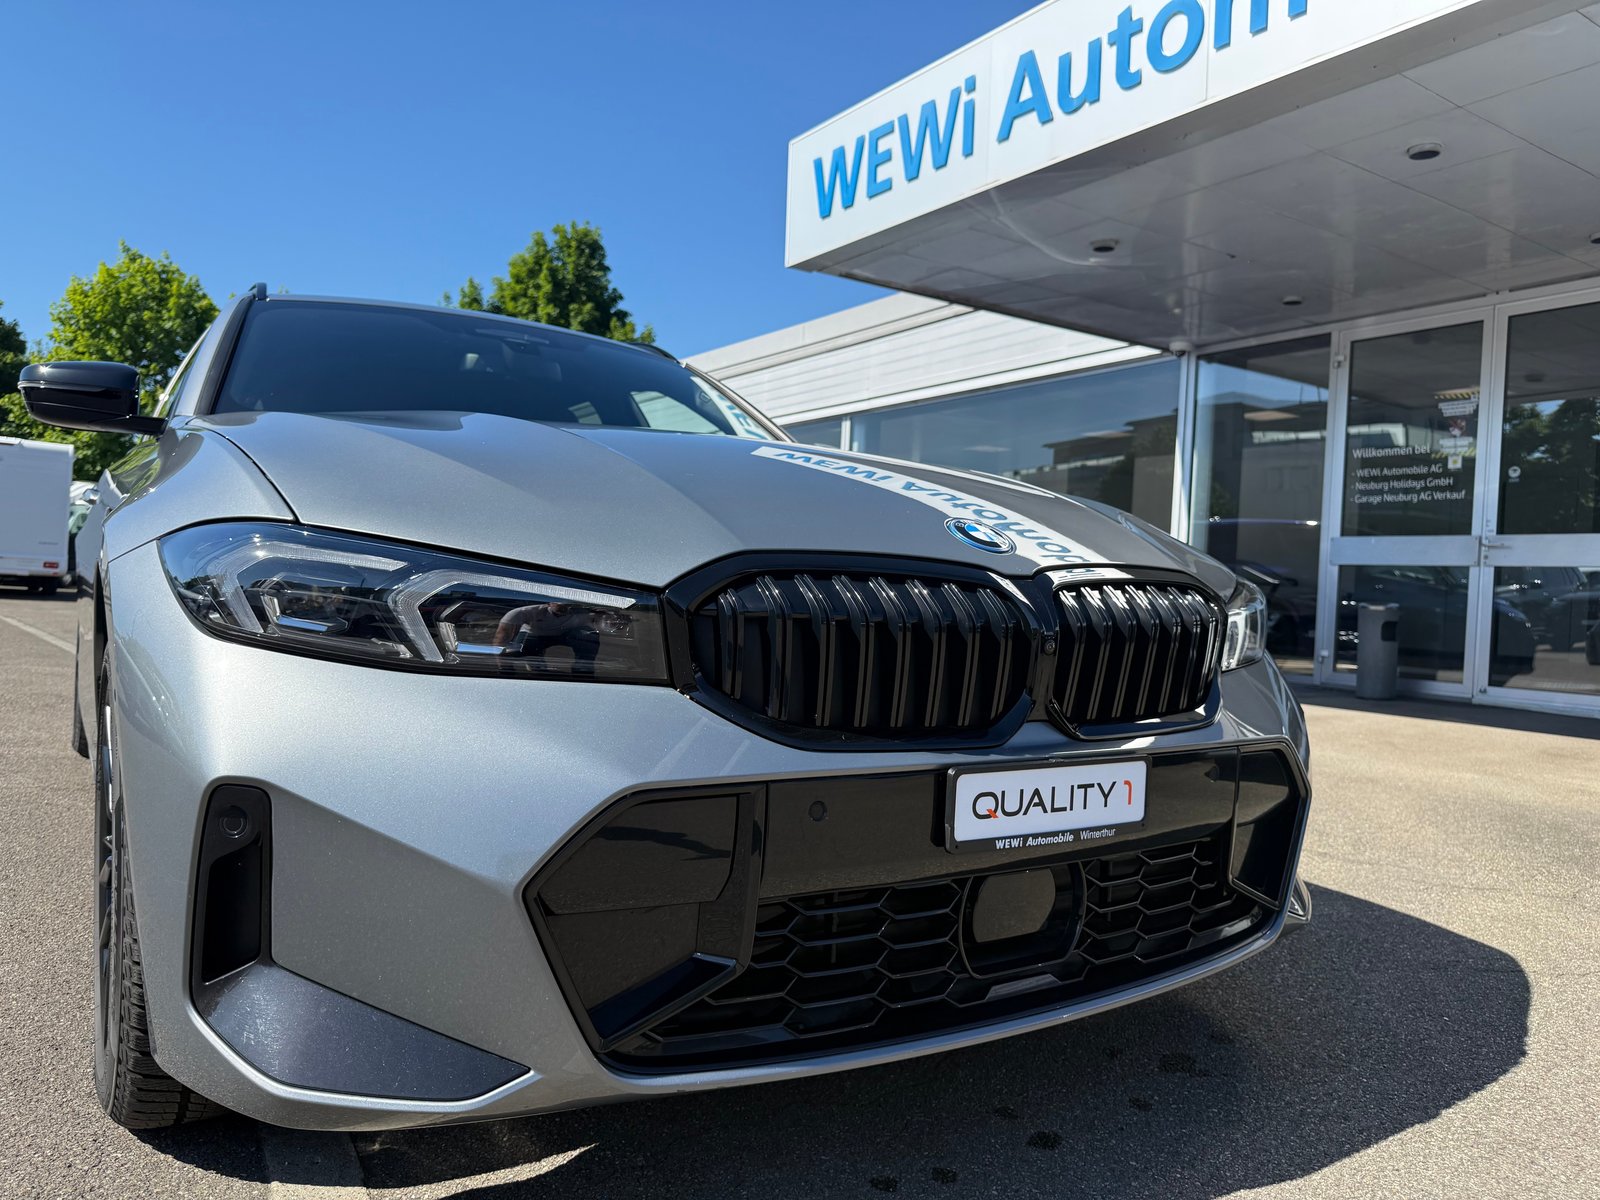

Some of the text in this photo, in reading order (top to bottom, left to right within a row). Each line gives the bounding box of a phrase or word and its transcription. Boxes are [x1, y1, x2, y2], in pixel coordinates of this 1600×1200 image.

[813, 75, 976, 219] WEWi
[1352, 446, 1413, 459] Willkommen
[1382, 465, 1428, 477] Automobile
[1430, 464, 1443, 474] AG
[1355, 477, 1453, 491] Neuburg Holidays GmbH
[1354, 489, 1466, 505] Garage Neuburg AG Verkauf
[972, 779, 1133, 820] QUALITY 1
[995, 828, 1116, 849] WEWi Automobile Winterthur
